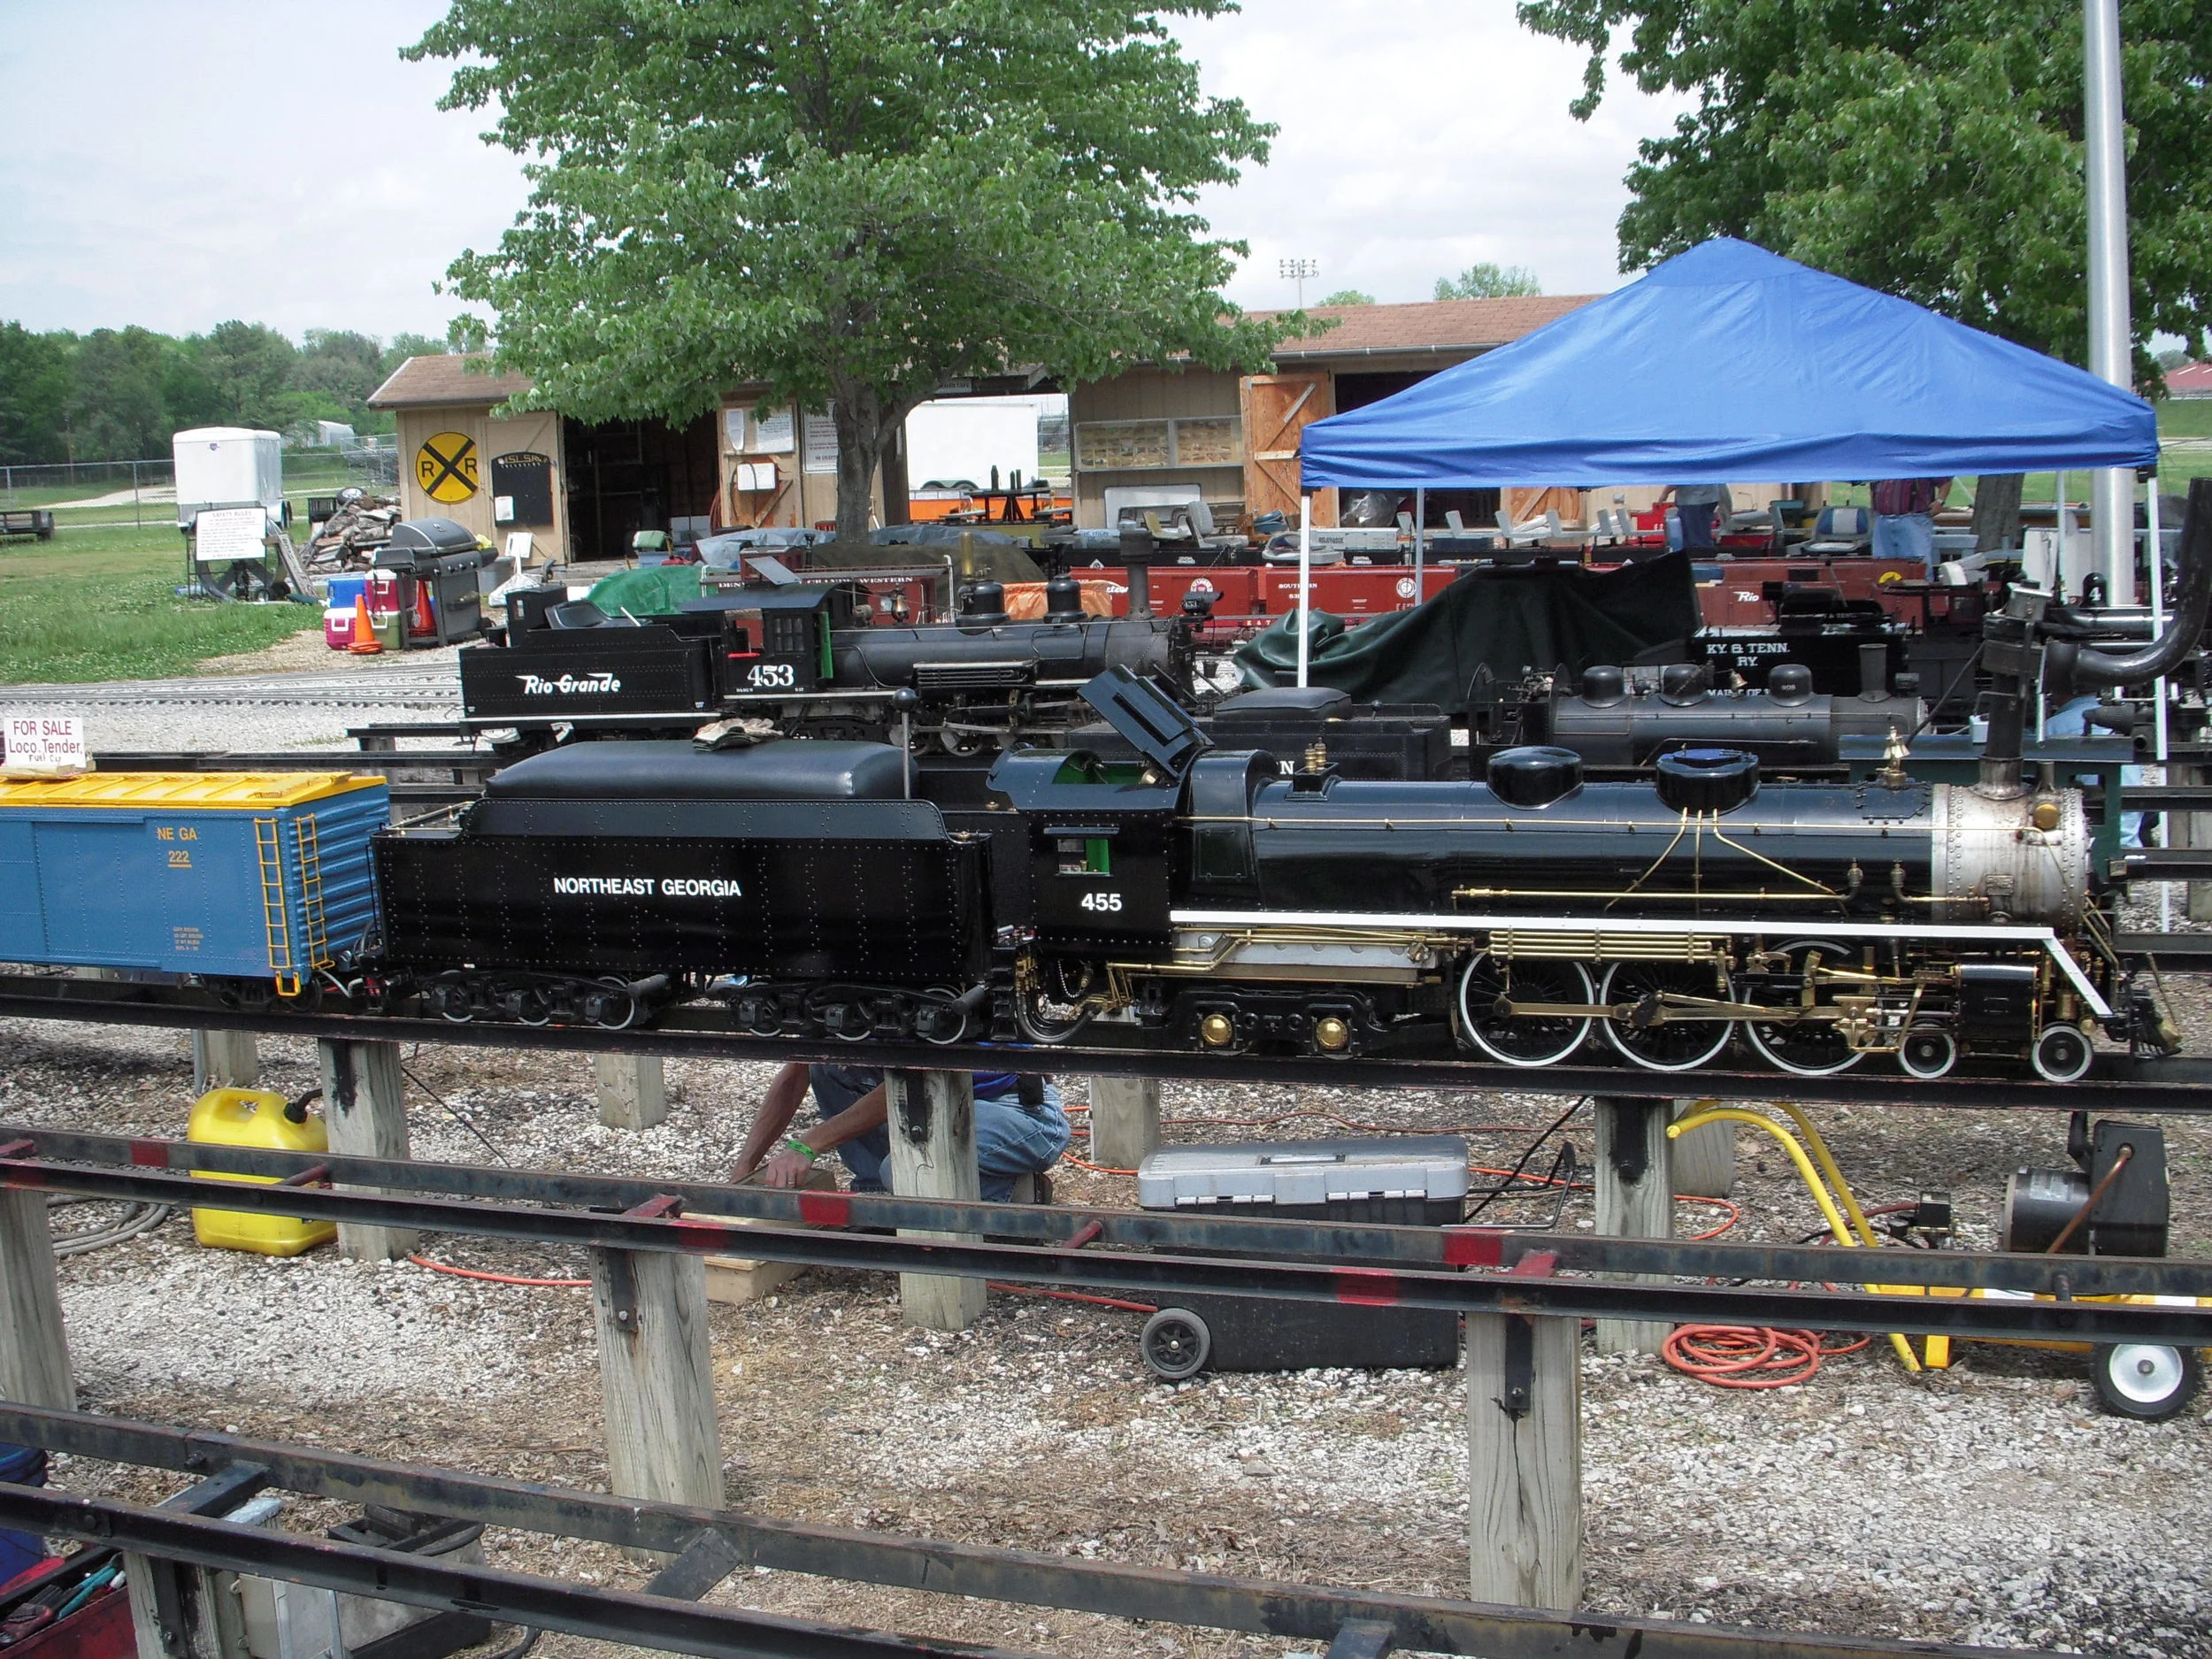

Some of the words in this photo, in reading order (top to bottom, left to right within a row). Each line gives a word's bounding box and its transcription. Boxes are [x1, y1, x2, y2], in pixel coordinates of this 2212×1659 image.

[421, 461, 434, 478] R
[465, 457, 478, 474] R
[1732, 591, 1759, 602] Rio
[2089, 587, 2102, 602] 4
[514, 675, 553, 694] Rio
[552, 672, 621, 693] Grande
[747, 664, 795, 687] 453
[13, 720, 37, 735] FOR
[42, 720, 73, 735] SALE
[157, 827, 175, 840] NE
[179, 827, 197, 841] GA
[168, 850, 190, 863] 222
[553, 878, 655, 895] NORTHEAST
[661, 879, 741, 896] GEORGIA
[1081, 894, 1122, 911] 455
